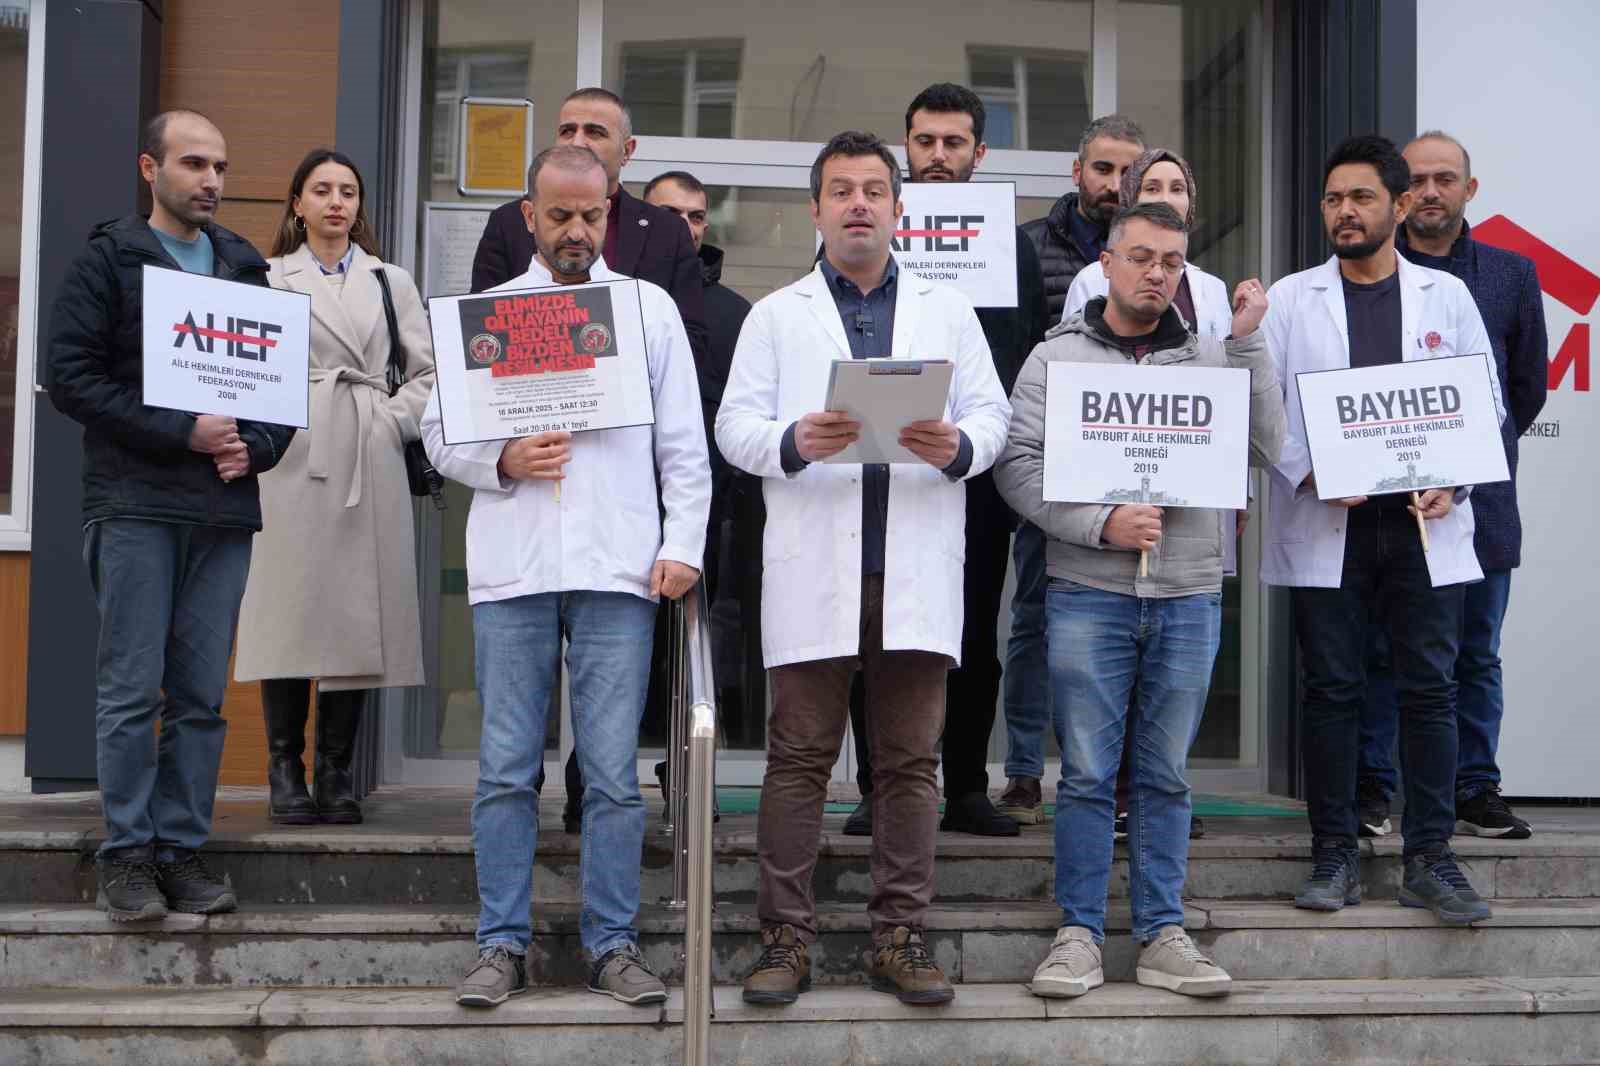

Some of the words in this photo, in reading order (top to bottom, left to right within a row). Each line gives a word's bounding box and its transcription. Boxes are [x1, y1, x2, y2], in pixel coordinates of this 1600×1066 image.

[934, 260, 986, 270] DERNEKLERİ
[172, 309, 282, 362] AHEF
[171, 358, 189, 369] AİLE
[191, 361, 234, 376] HEKİMLERİ
[235, 368, 282, 383] DERNEKLERİ
[198, 375, 256, 391] FEDERASYONU
[507, 406, 534, 416] ARALIK
[535, 404, 553, 413] 2025
[559, 402, 578, 410] SAAT
[1081, 390, 1213, 428] BAYHED
[1335, 384, 1461, 425] BAYHED
[1343, 426, 1387, 440] BAYBURT
[1390, 423, 1411, 436] AİLE
[1413, 418, 1464, 433] HEKİMLERİ
[1082, 431, 1128, 442] BAYBURT
[1131, 430, 1154, 444] AİLE
[1157, 431, 1211, 445] HEKİMLERİ
[1385, 436, 1427, 449] DERNEĞİ
[1124, 446, 1168, 459] DERNEĞİ
[1396, 451, 1421, 462] 2019
[1133, 463, 1158, 474] 2019
